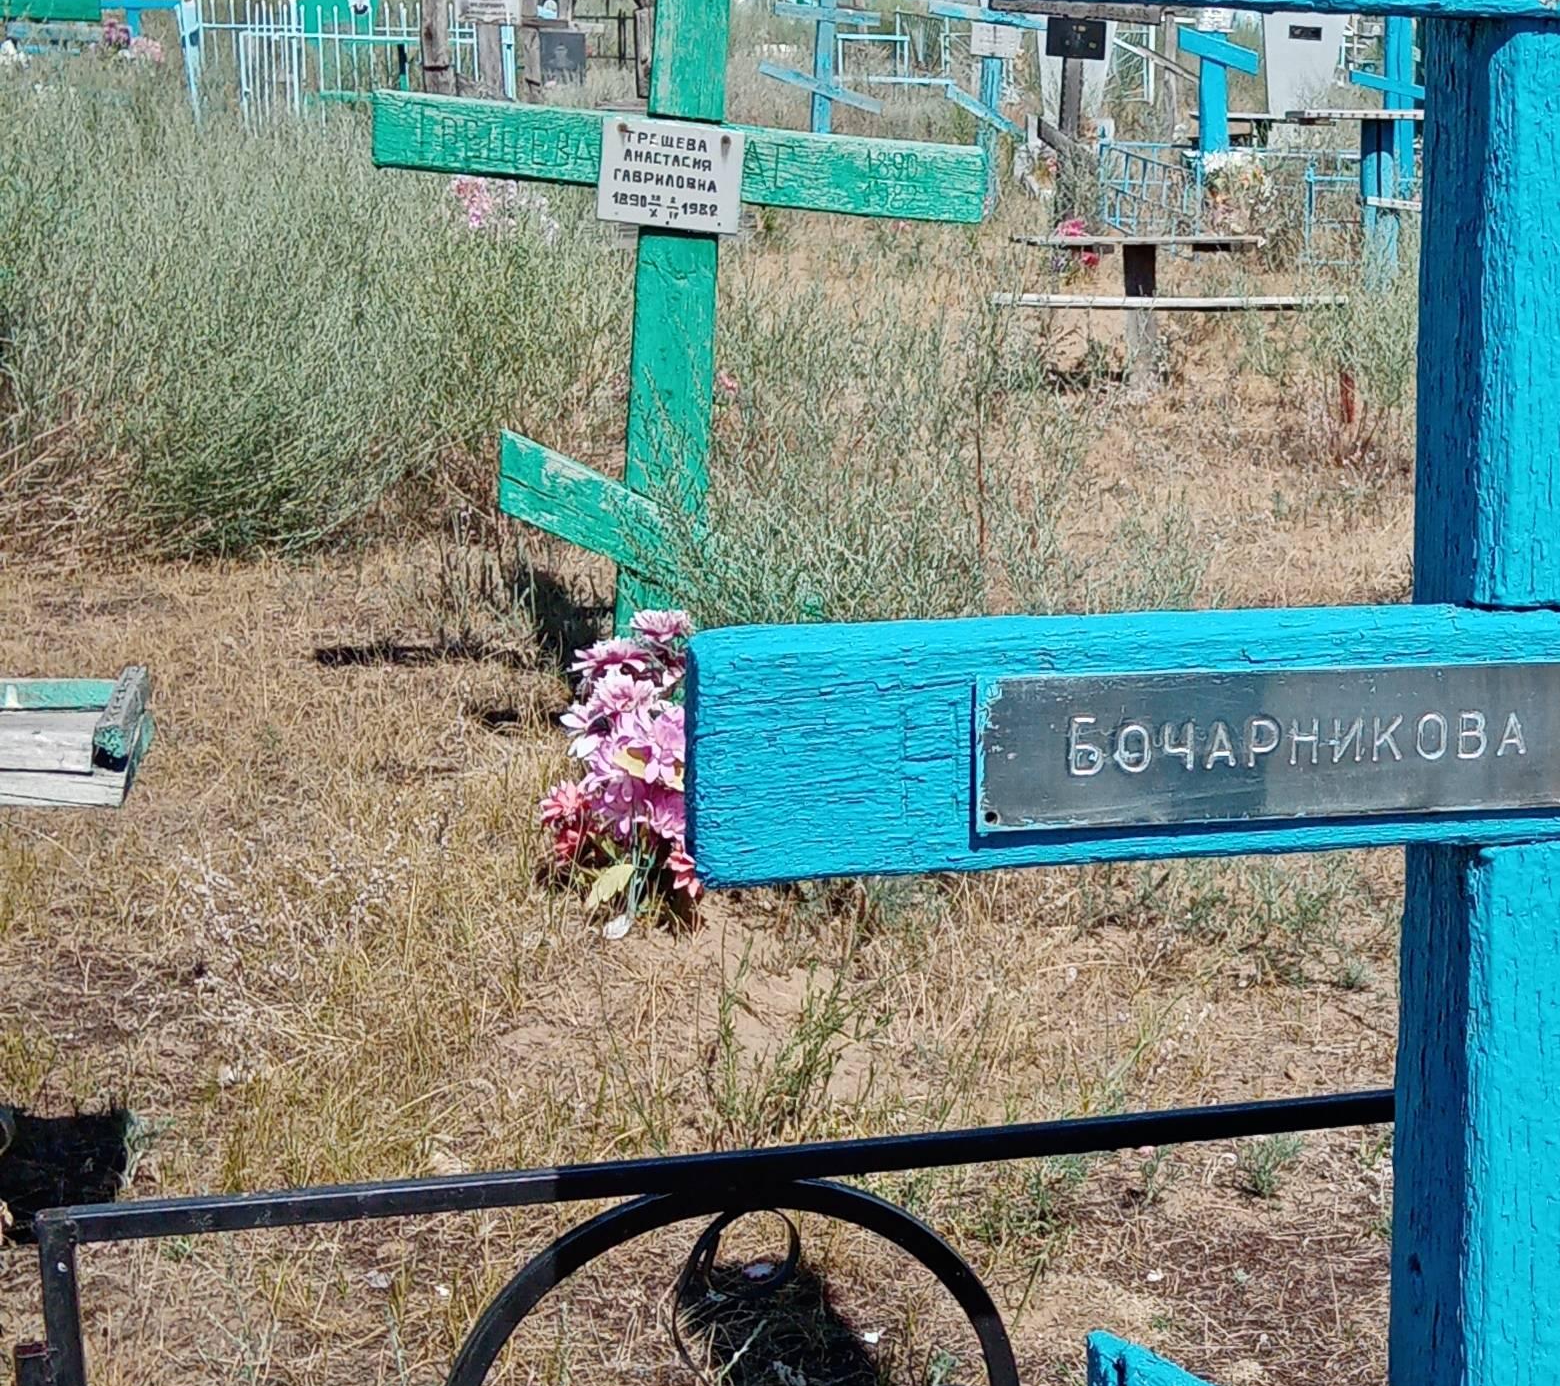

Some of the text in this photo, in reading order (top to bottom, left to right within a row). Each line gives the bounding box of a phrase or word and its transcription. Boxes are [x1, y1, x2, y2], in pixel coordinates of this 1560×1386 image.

[623, 148, 712, 172] АНАСТАСИЯ
[613, 168, 718, 193] ГАВРИЛОВНА
[612, 191, 647, 208] 1890
[681, 202, 718, 217] 1982
[1067, 711, 1528, 777] БОЧАРНИКОВА
